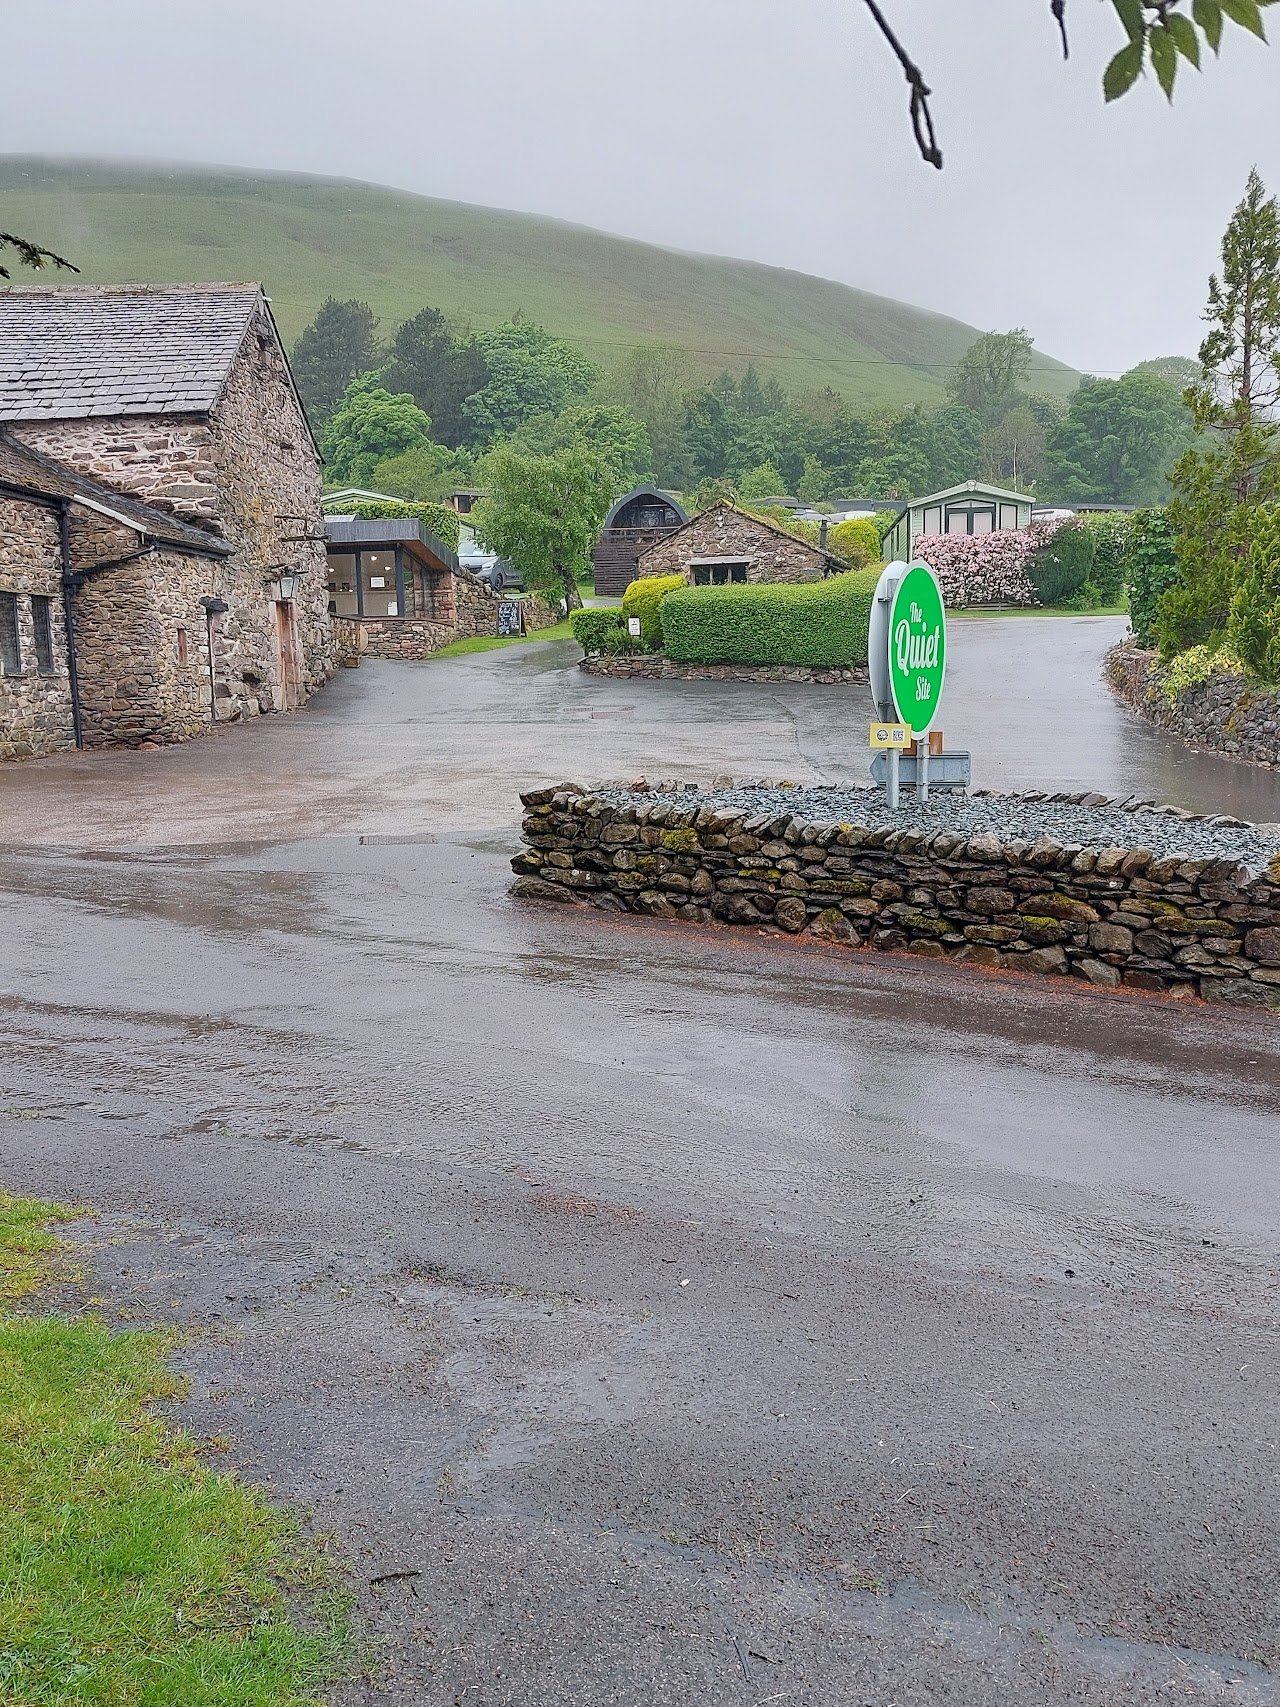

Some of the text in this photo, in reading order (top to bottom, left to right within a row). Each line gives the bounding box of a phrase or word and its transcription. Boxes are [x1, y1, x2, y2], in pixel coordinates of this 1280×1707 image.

[910, 602, 923, 623] The
[895, 619, 940, 676] Quiet
[916, 676, 931, 701] Site
